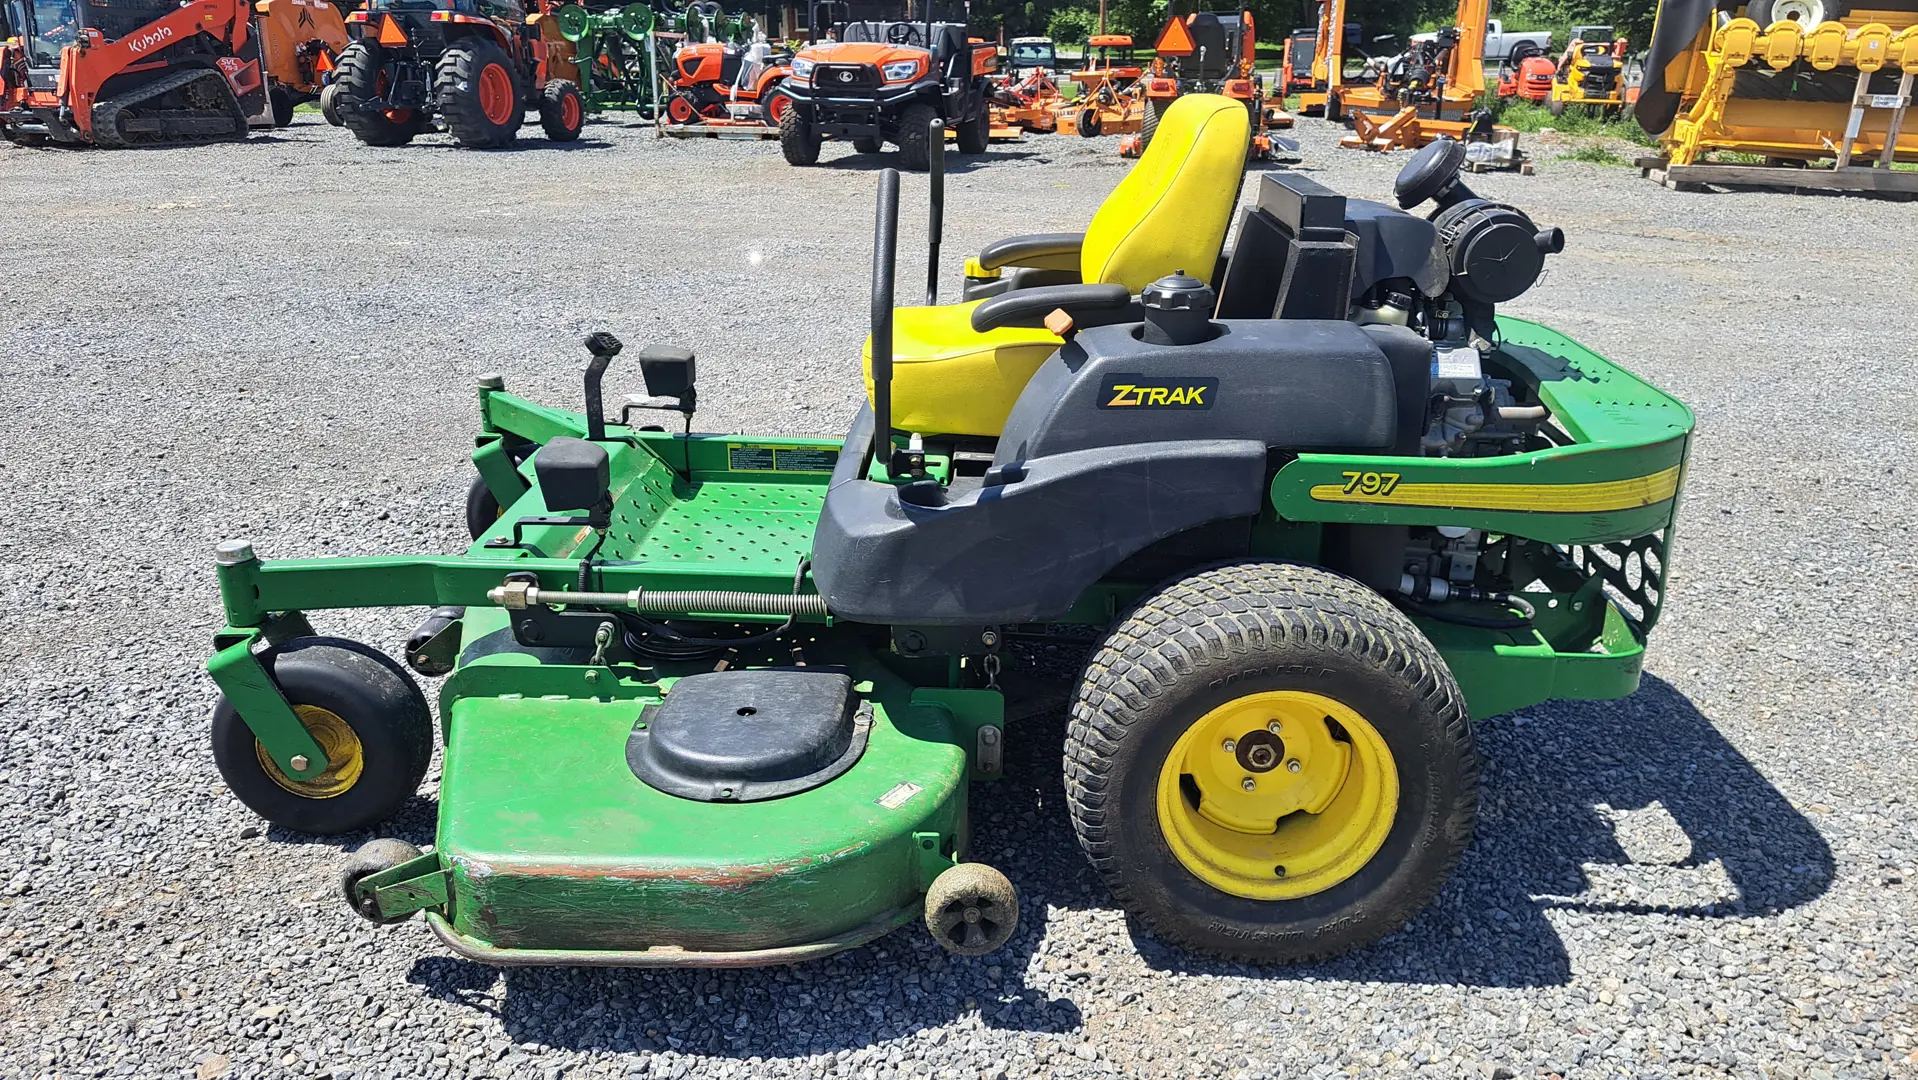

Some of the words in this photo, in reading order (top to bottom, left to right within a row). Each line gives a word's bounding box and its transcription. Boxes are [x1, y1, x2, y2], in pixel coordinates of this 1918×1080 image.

[128, 26, 172, 52] Kubota
[1106, 384, 1208, 407] ZTRAK
[1342, 471, 1401, 496] 797
